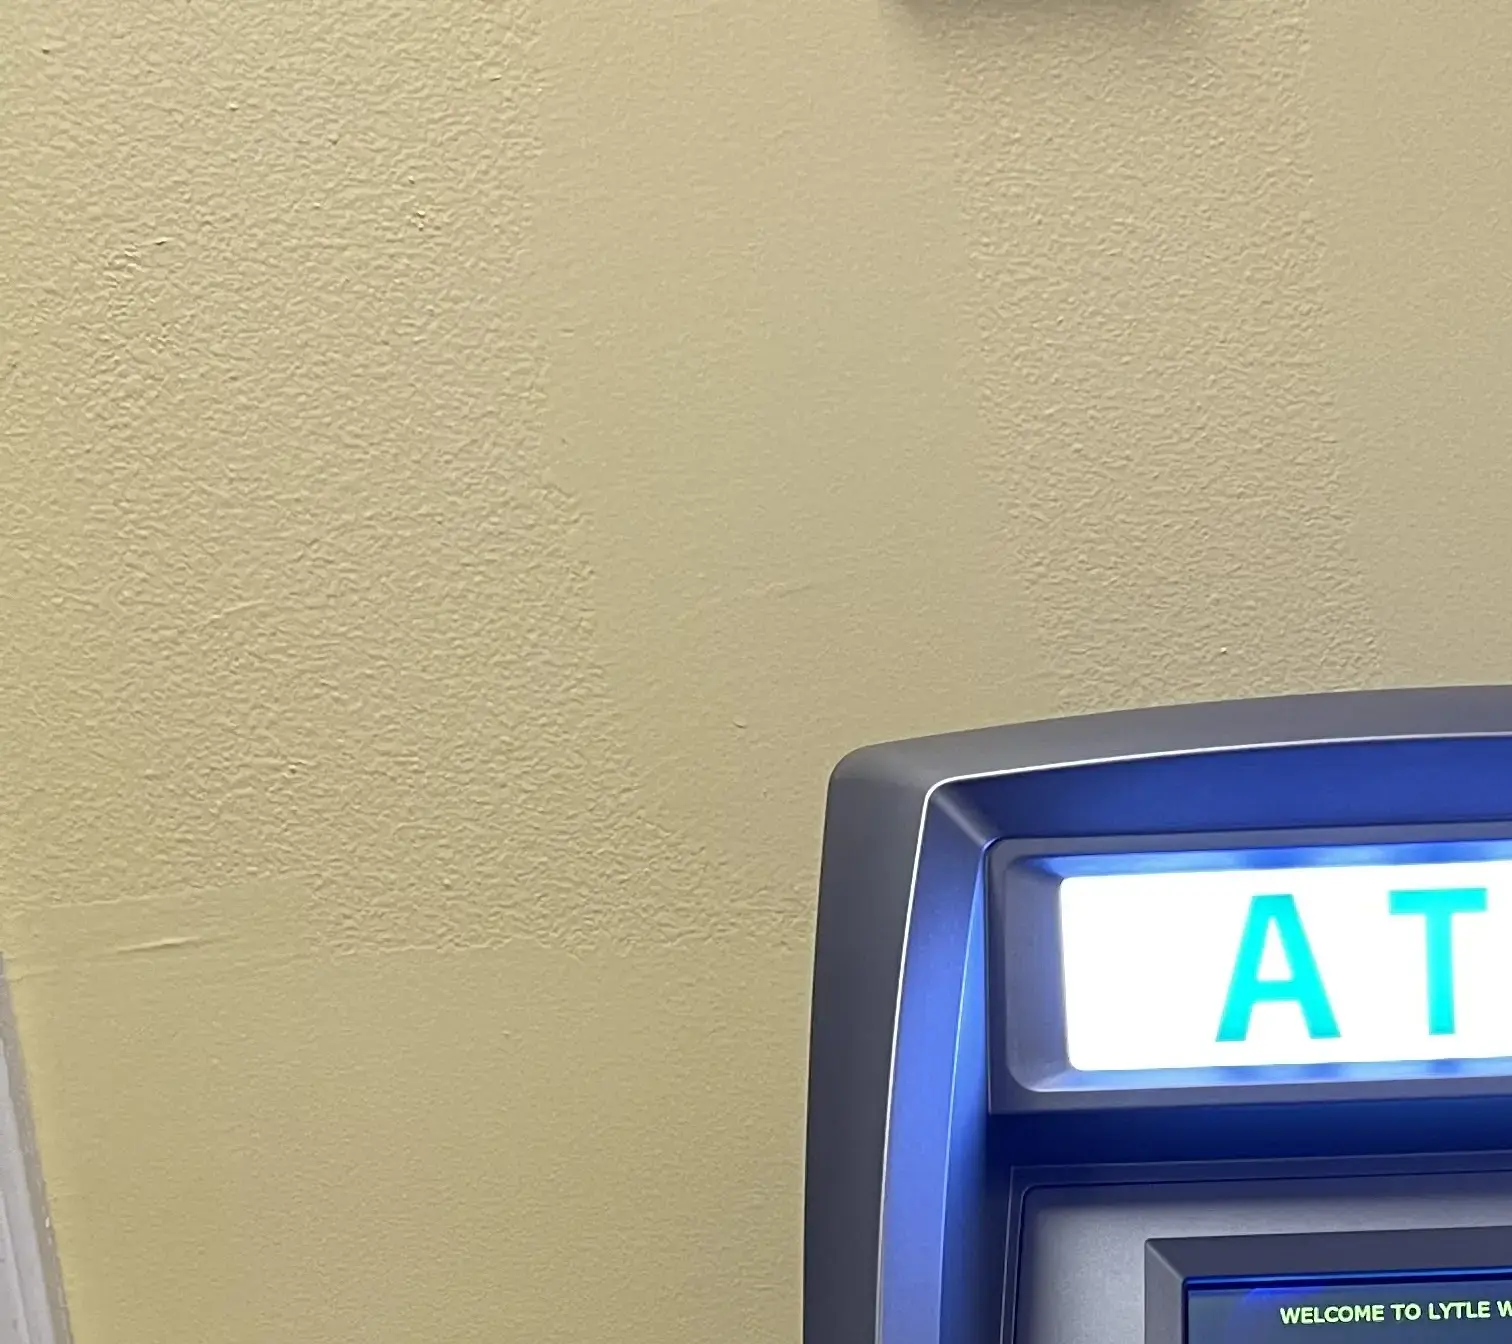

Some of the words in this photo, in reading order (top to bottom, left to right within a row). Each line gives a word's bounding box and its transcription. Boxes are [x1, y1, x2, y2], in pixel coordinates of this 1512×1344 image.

[1280, 1305, 1384, 1324] WELCOME
[1391, 1303, 1421, 1320] TO
[1429, 1301, 1490, 1319] LYTLE
